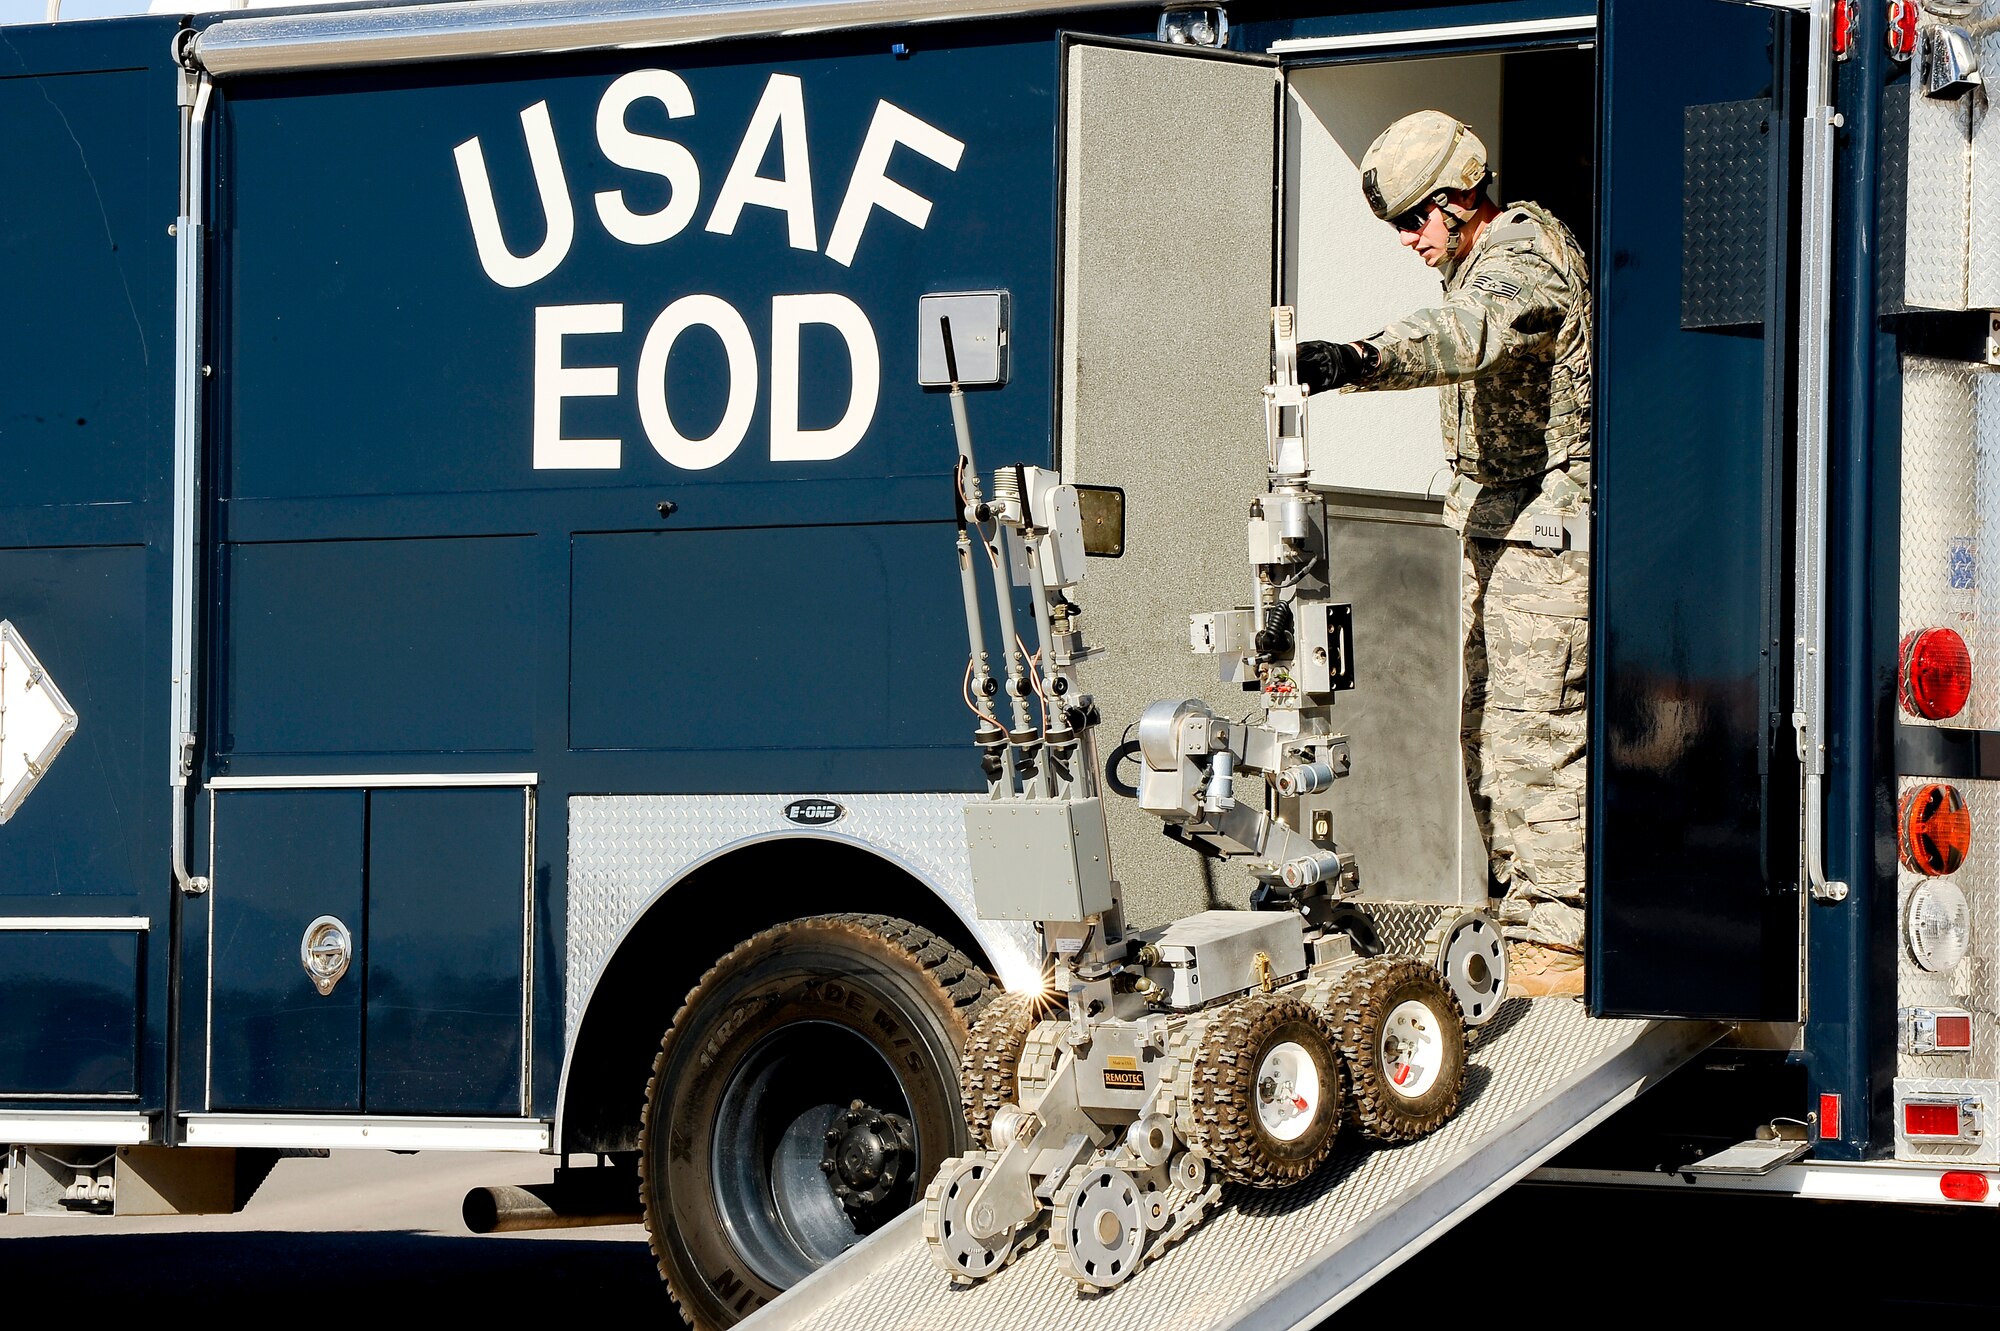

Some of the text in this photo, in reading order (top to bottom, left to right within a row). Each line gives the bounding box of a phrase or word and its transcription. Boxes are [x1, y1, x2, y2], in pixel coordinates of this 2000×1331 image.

[453, 68, 966, 288] USAF
[533, 293, 881, 470] EOD
[1534, 525, 1560, 538] PULL
[789, 805, 836, 818] E-ONE
[1104, 1073, 1142, 1083] REMOTEC
